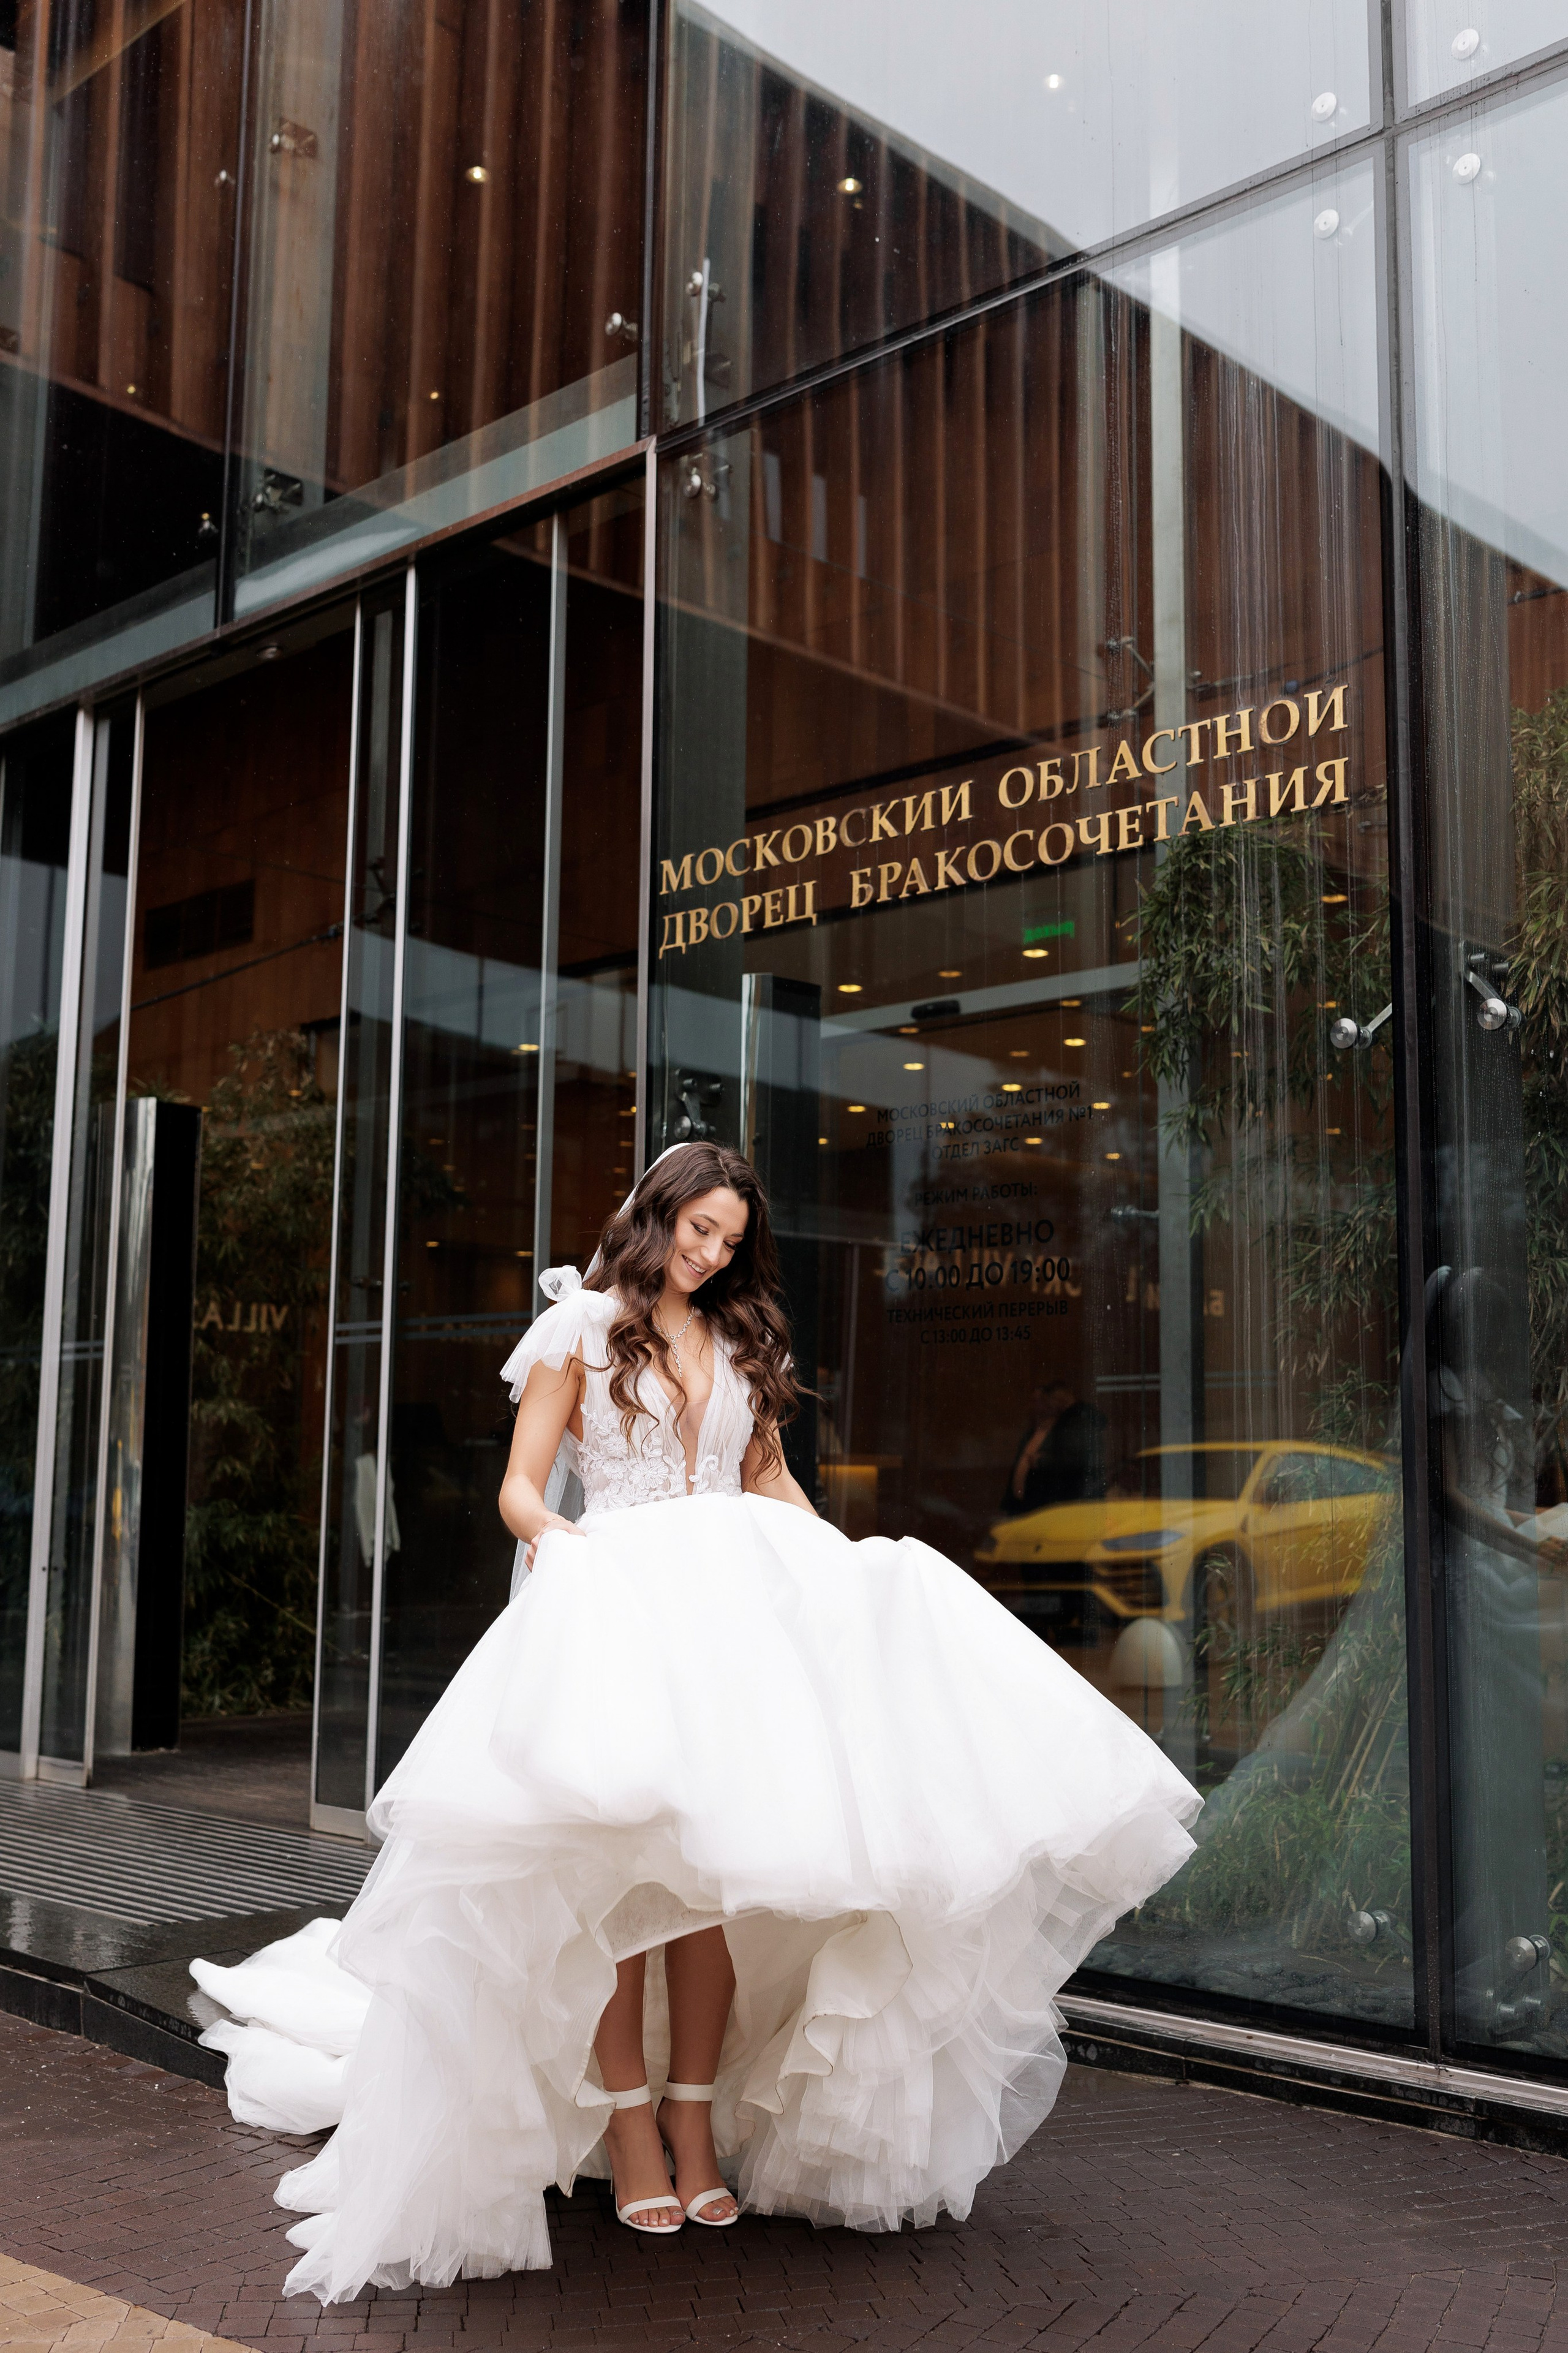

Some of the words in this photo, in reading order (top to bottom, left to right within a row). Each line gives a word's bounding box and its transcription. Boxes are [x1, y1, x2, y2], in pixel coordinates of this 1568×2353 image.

[658, 880, 818, 959] ДВОРЕЦ
[850, 757, 1349, 908] БРАКОСОЧЕТАНИЯ
[877, 1094, 979, 1124] МОСКОВСКИЙ
[983, 1080, 1080, 1109] ОБЛАСТНОЙ
[867, 1128, 924, 1148] ДВОРЕЦ
[927, 1108, 1065, 1139] БРАКОСОЧЕТАНИЯ
[932, 1141, 979, 1160] ОТДЕЛ
[983, 1137, 1019, 1155] ЗАГС
[914, 1188, 968, 1207] РЕЖИМ
[972, 1181, 1038, 1200] РАБОТЫ:
[900, 1219, 1054, 1255] ЕЖЕДНЕВНО
[907, 1264, 960, 1290] 10:00
[965, 1262, 1004, 1291] ДО
[1011, 1258, 1069, 1284] 19:00
[887, 1301, 994, 1323] ТЕХНИЧЕСКИЙ
[998, 1300, 1068, 1318] ПЕРЕРЫВ
[933, 1328, 966, 1343] 13:00
[970, 1327, 992, 1345] ДО
[997, 1326, 1031, 1340] 13:45
